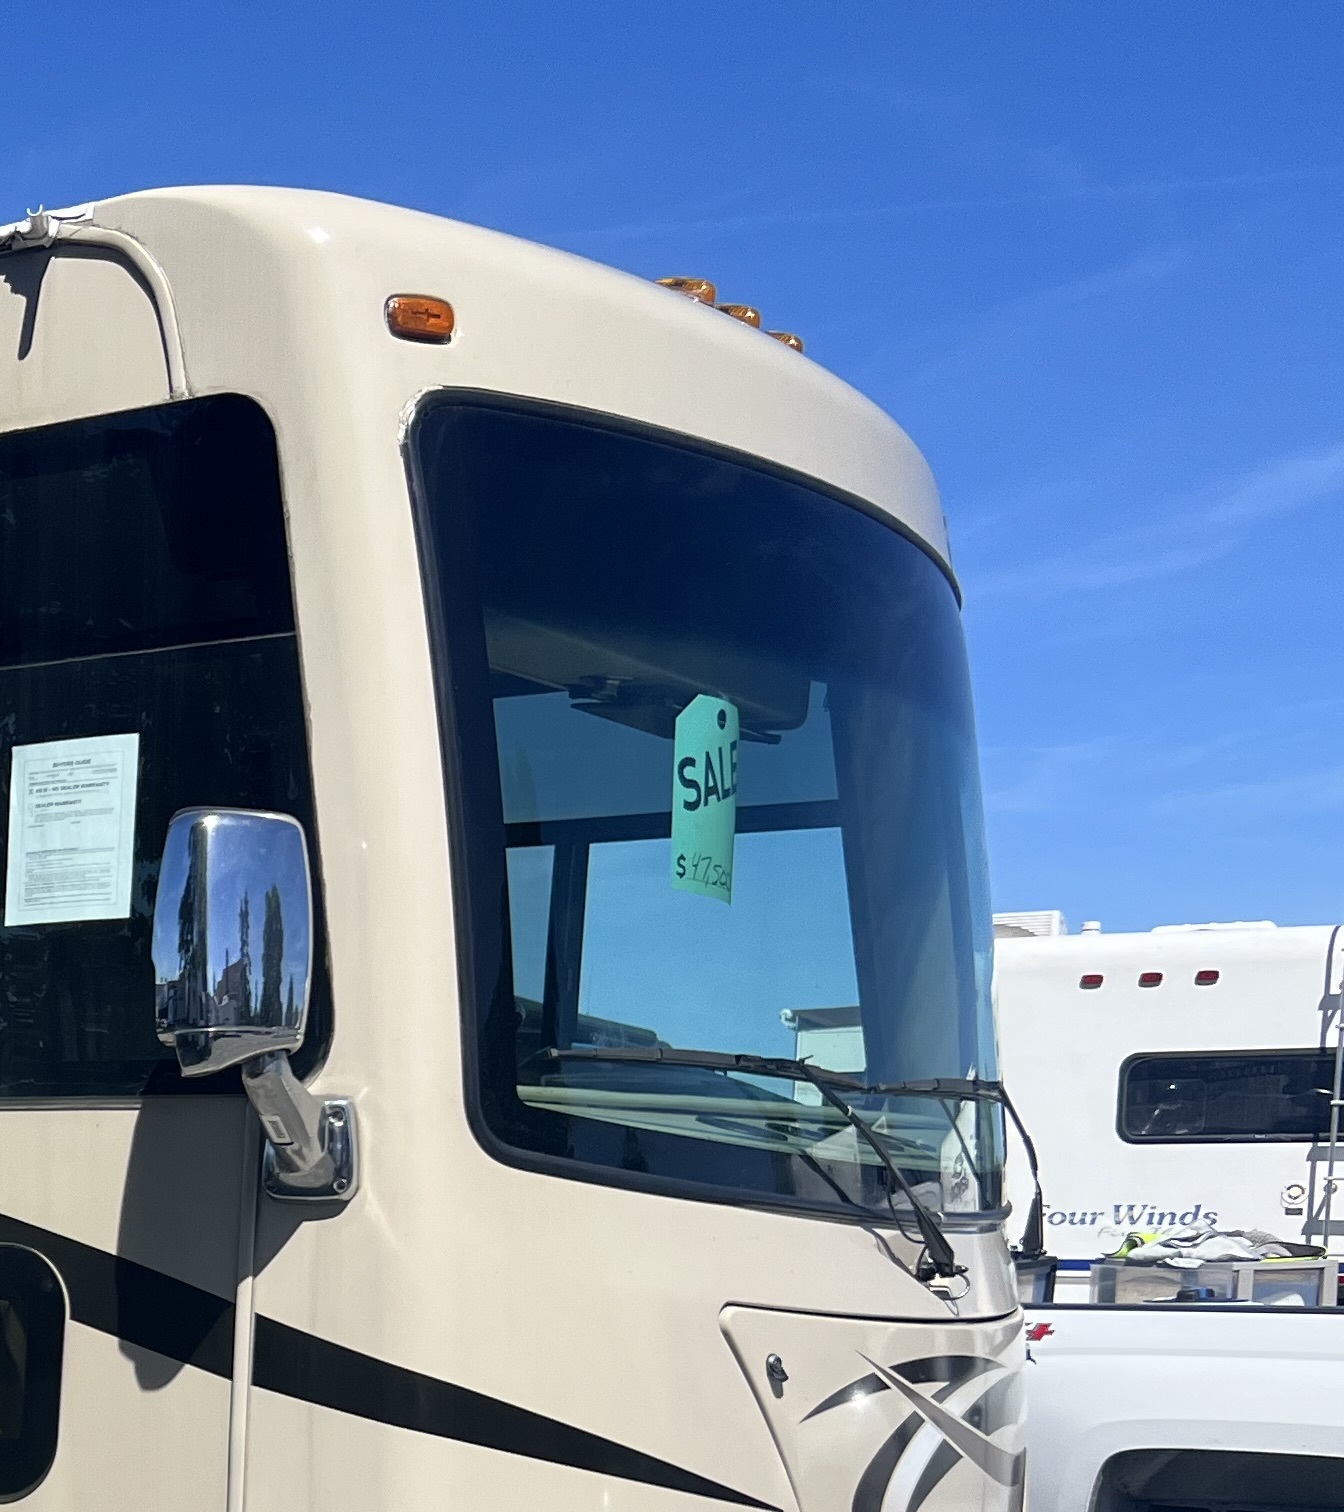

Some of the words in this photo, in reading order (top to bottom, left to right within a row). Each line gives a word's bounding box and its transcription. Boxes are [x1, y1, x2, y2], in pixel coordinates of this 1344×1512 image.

[677, 740, 738, 812] SALE
[676, 853, 687, 879] $
[1041, 1203, 1105, 1226] our
[1113, 1203, 1219, 1226] Winds
